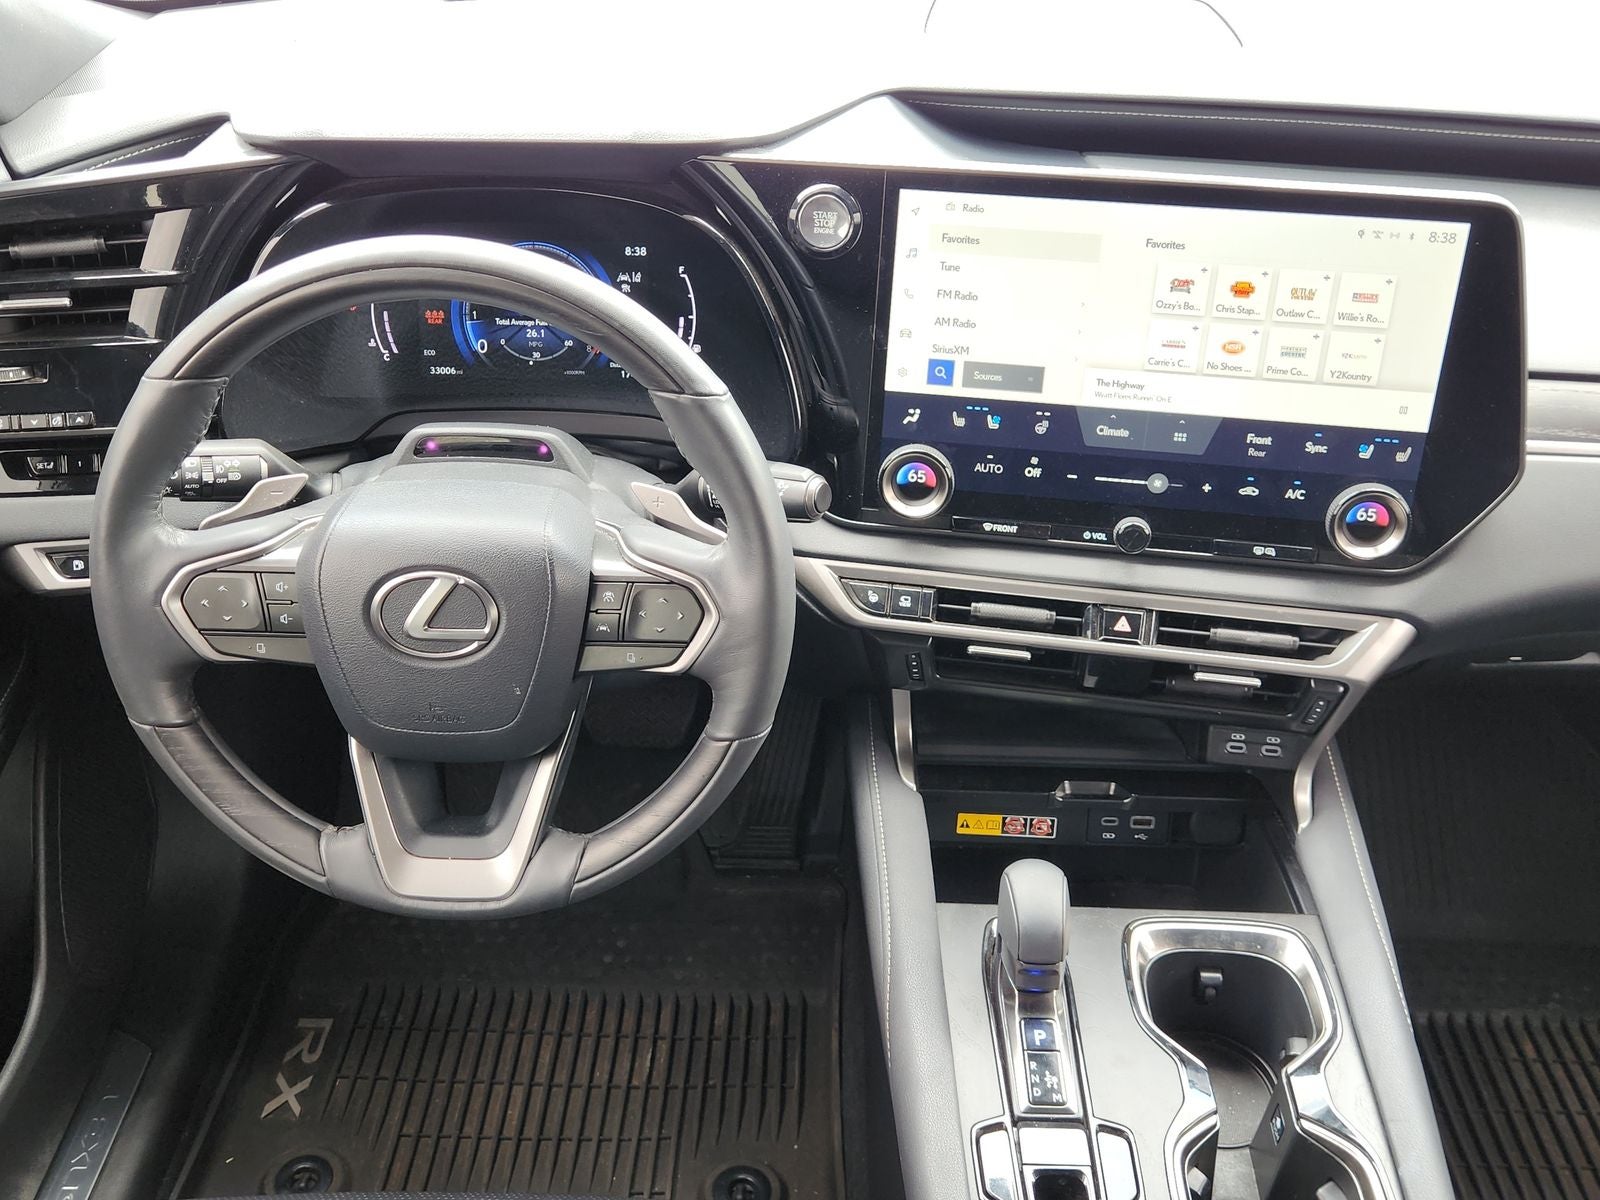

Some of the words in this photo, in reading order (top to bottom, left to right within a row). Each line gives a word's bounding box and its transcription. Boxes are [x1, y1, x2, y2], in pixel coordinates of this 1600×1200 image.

[962, 204, 985, 214] Radio
[812, 211, 838, 219] START
[814, 219, 836, 227] STOP
[941, 233, 981, 246] Favorites
[1428, 231, 1457, 244] 8:38
[1145, 238, 1185, 250] Favorites
[625, 246, 647, 256] 8:38
[678, 266, 685, 274] F
[939, 261, 961, 273] Tune
[936, 289, 953, 300] FM
[953, 291, 978, 302] Radio
[1155, 299, 1182, 310] Ozzy's
[1215, 304, 1236, 314] Chris
[472, 310, 477, 319] 1
[1276, 308, 1306, 318] Outlaw
[495, 318, 510, 326] Total
[510, 318, 535, 327] Average
[934, 317, 951, 327] AM
[952, 318, 977, 329] Radio
[526, 329, 545, 338] 26.1
[477, 339, 488, 353] 0
[932, 344, 970, 356] SiriusXM
[383, 352, 390, 361] C
[1147, 357, 1176, 367] Carrie's
[430, 366, 456, 375] 33006
[1206, 361, 1219, 370] No
[1220, 362, 1243, 372] Shoes
[1266, 365, 1289, 376] Prime
[973, 371, 1003, 382] Sources
[1329, 369, 1372, 383] Y2Kountry
[1096, 378, 1111, 387] The
[1111, 379, 1145, 391] Highway
[1096, 424, 1130, 438] Climate
[1246, 433, 1272, 446] Front
[1247, 447, 1267, 458] Rear
[1304, 441, 1328, 454] Sync
[974, 462, 1004, 474] AUTO
[1024, 466, 1043, 478] Off
[907, 469, 927, 483] 65
[1284, 488, 1307, 500] A/C
[1355, 507, 1377, 523] 65
[993, 524, 1018, 534] FRONT
[1091, 531, 1107, 541] VOL
[1033, 1029, 1047, 1046] P
[261, 1017, 334, 1119] RX
[1030, 1061, 1038, 1071] R
[1031, 1074, 1040, 1083] N
[1032, 1087, 1042, 1097] D
[1052, 1093, 1062, 1103] M
